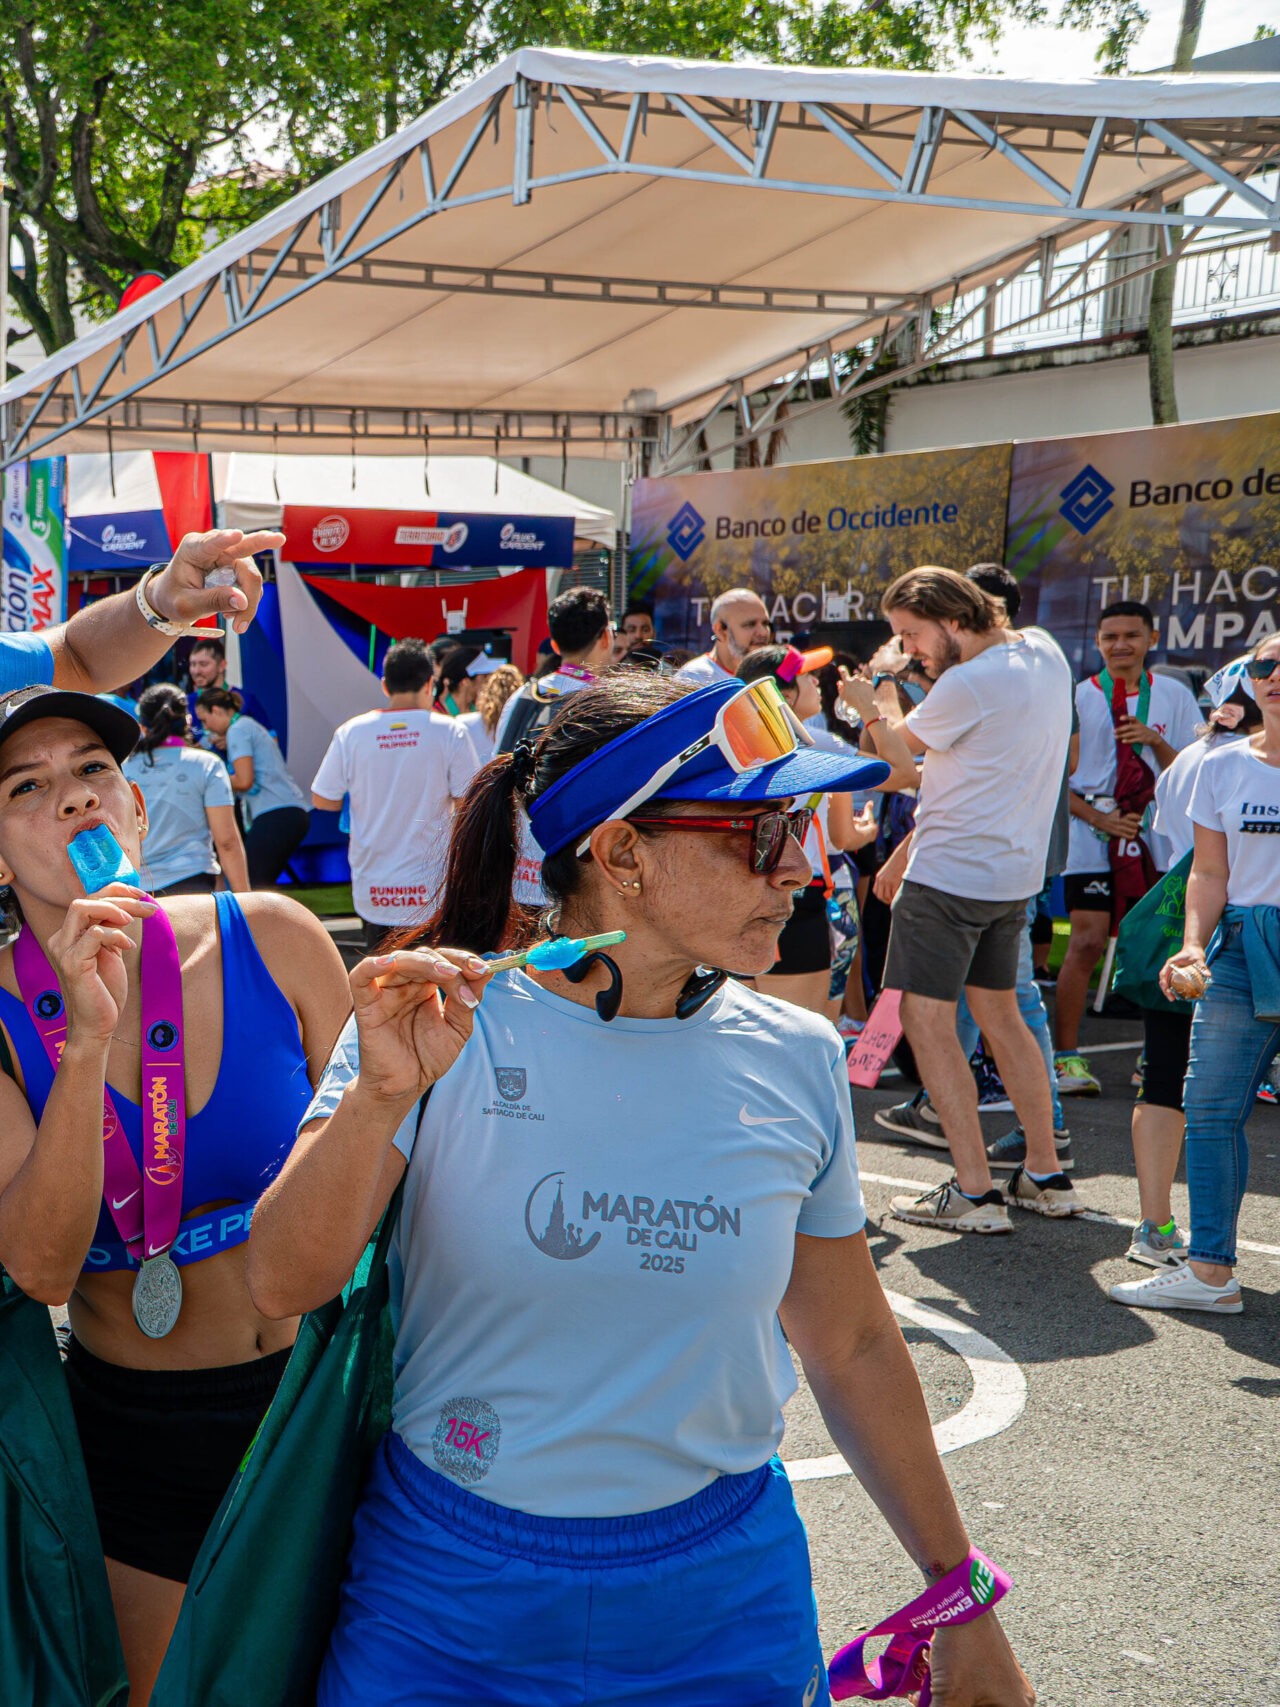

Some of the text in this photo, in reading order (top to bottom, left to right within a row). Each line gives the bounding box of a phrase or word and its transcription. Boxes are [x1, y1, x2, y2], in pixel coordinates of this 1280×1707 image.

[1129, 467, 1280, 508] Banco de
[715, 501, 959, 540] Banco de Occidente
[101, 539, 147, 552] CARDENT
[500, 540, 546, 551] CARDENT
[369, 885, 428, 897] RUNNING
[370, 896, 428, 908] SOCIAL
[147, 1076, 168, 1160] MARATÓN
[167, 1099, 178, 1136] DE CALI
[516, 1111, 528, 1120] DE
[528, 1112, 545, 1121] CALI
[582, 1190, 741, 1237] MARATÓN
[626, 1226, 698, 1252] DE CALI
[639, 1252, 686, 1275] 2025
[445, 1417, 490, 1458] 15K
[912, 1595, 975, 1629] EMCALI
